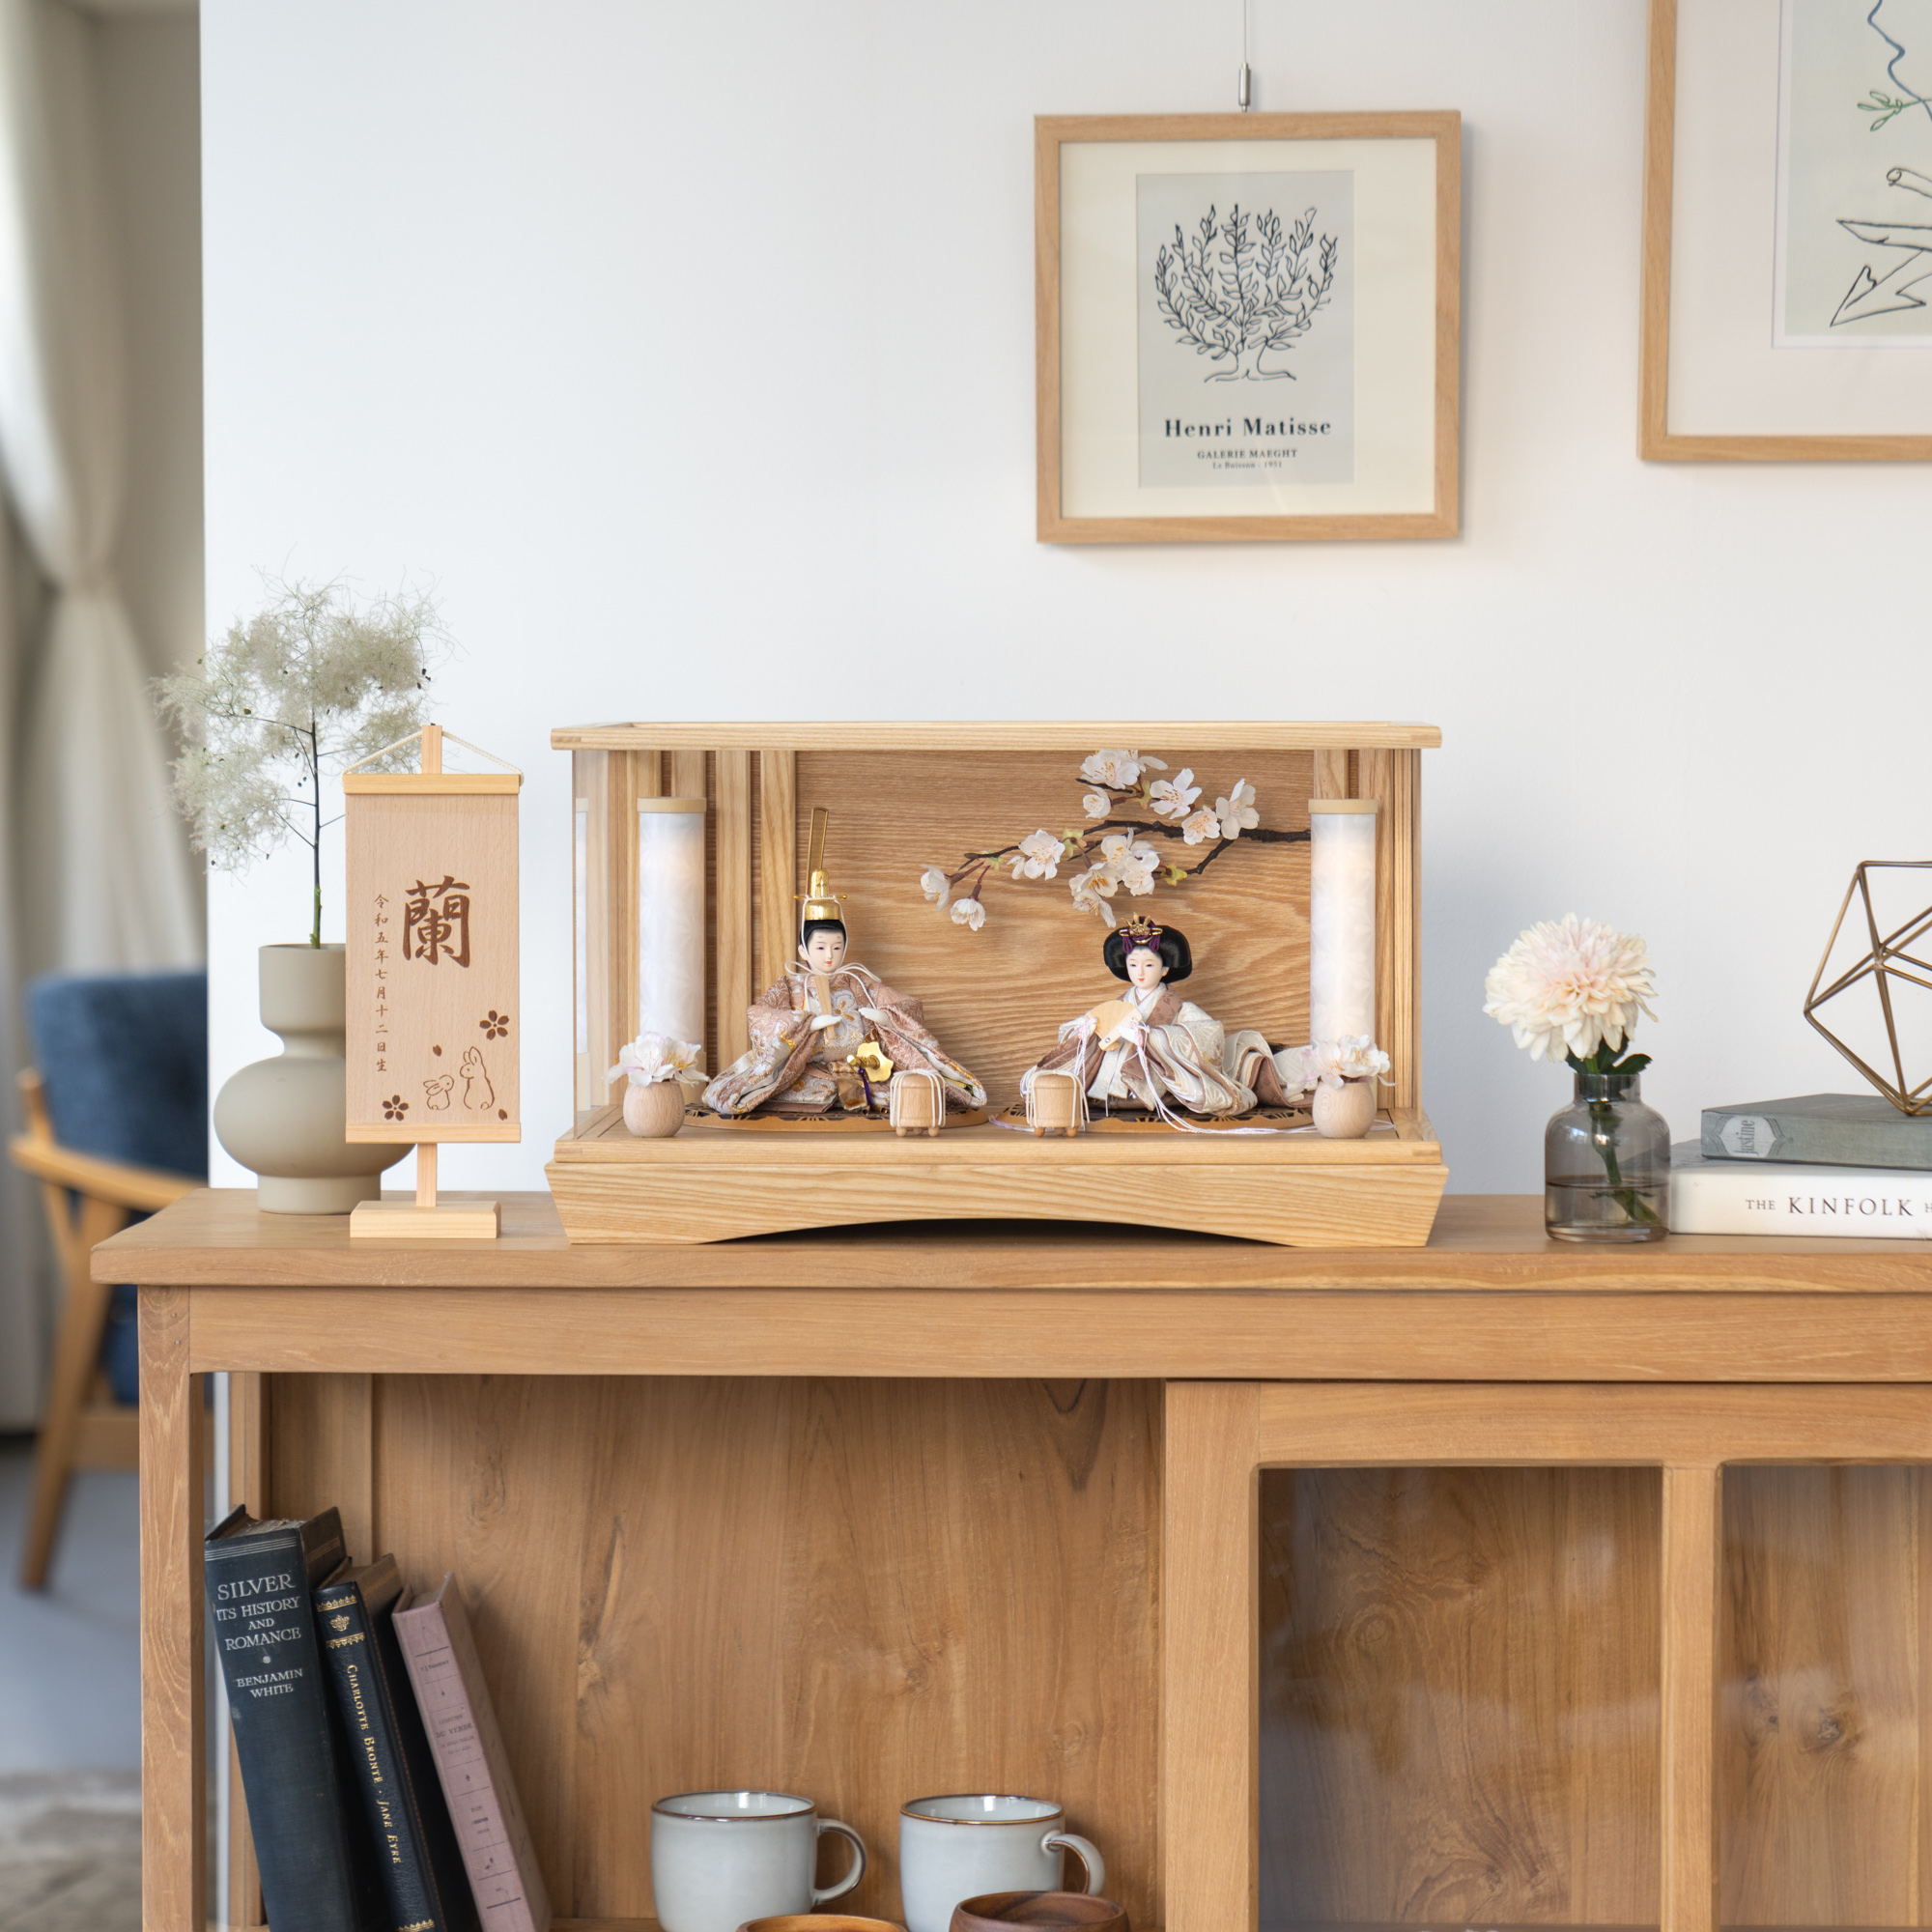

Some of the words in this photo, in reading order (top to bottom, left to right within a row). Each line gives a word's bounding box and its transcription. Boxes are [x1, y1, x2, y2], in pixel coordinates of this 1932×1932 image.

[1165, 418, 1232, 438] Henri
[1244, 417, 1331, 436] Matisse
[1197, 450, 1245, 460] GALERIE
[1249, 449, 1297, 459] MAEGHT
[403, 875, 470, 968] 蘭
[374, 894, 388, 1072] 令和五年七月十二日生
[1735, 1120, 1759, 1156] Justine
[1746, 1199, 1776, 1209] THE
[1788, 1197, 1914, 1216] KINFOLK
[217, 1574, 296, 1601] SILVER
[216, 1607, 237, 1621] ITS
[242, 1596, 300, 1618] HISTORY
[248, 1618, 274, 1630] AND
[225, 1627, 301, 1650] ROMANCE
[236, 1668, 303, 1688] BENJAMIN
[249, 1684, 294, 1698] WHITE
[347, 1664, 369, 1730] CHARLOTTE
[376, 1799, 393, 1828] JANE
[386, 1834, 402, 1863] EYRE
